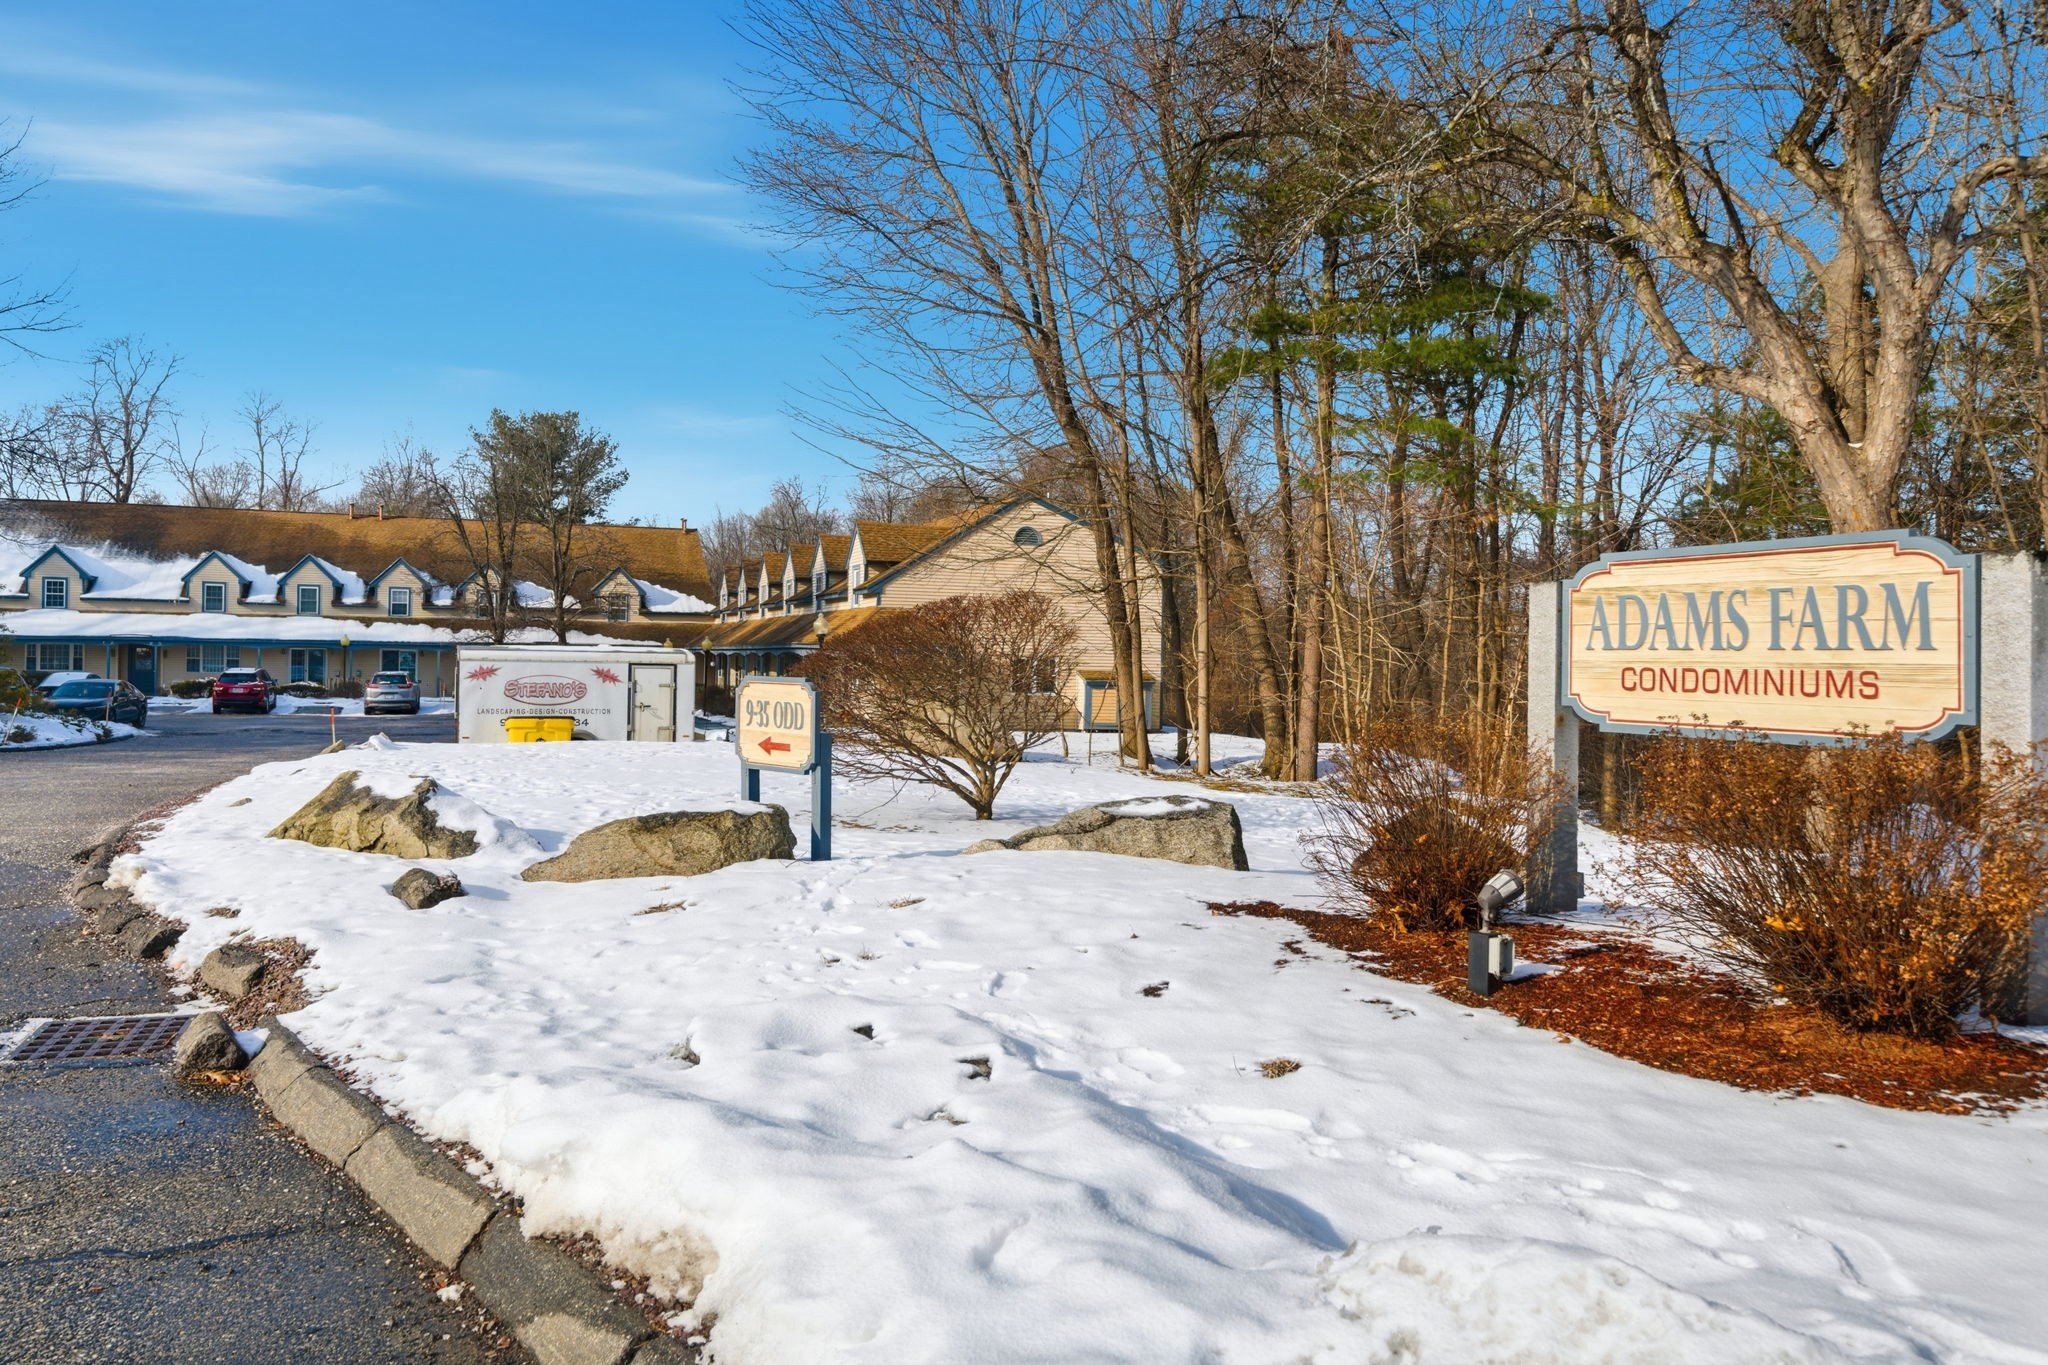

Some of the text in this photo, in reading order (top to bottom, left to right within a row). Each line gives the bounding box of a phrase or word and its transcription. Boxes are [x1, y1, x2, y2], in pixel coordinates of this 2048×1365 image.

[1585, 580, 1939, 651] ADAMS FARM
[503, 679, 588, 699] STEFANO'S
[1620, 666, 1880, 700] CONDOMINIUMS
[746, 699, 805, 731] 9-35 ODD
